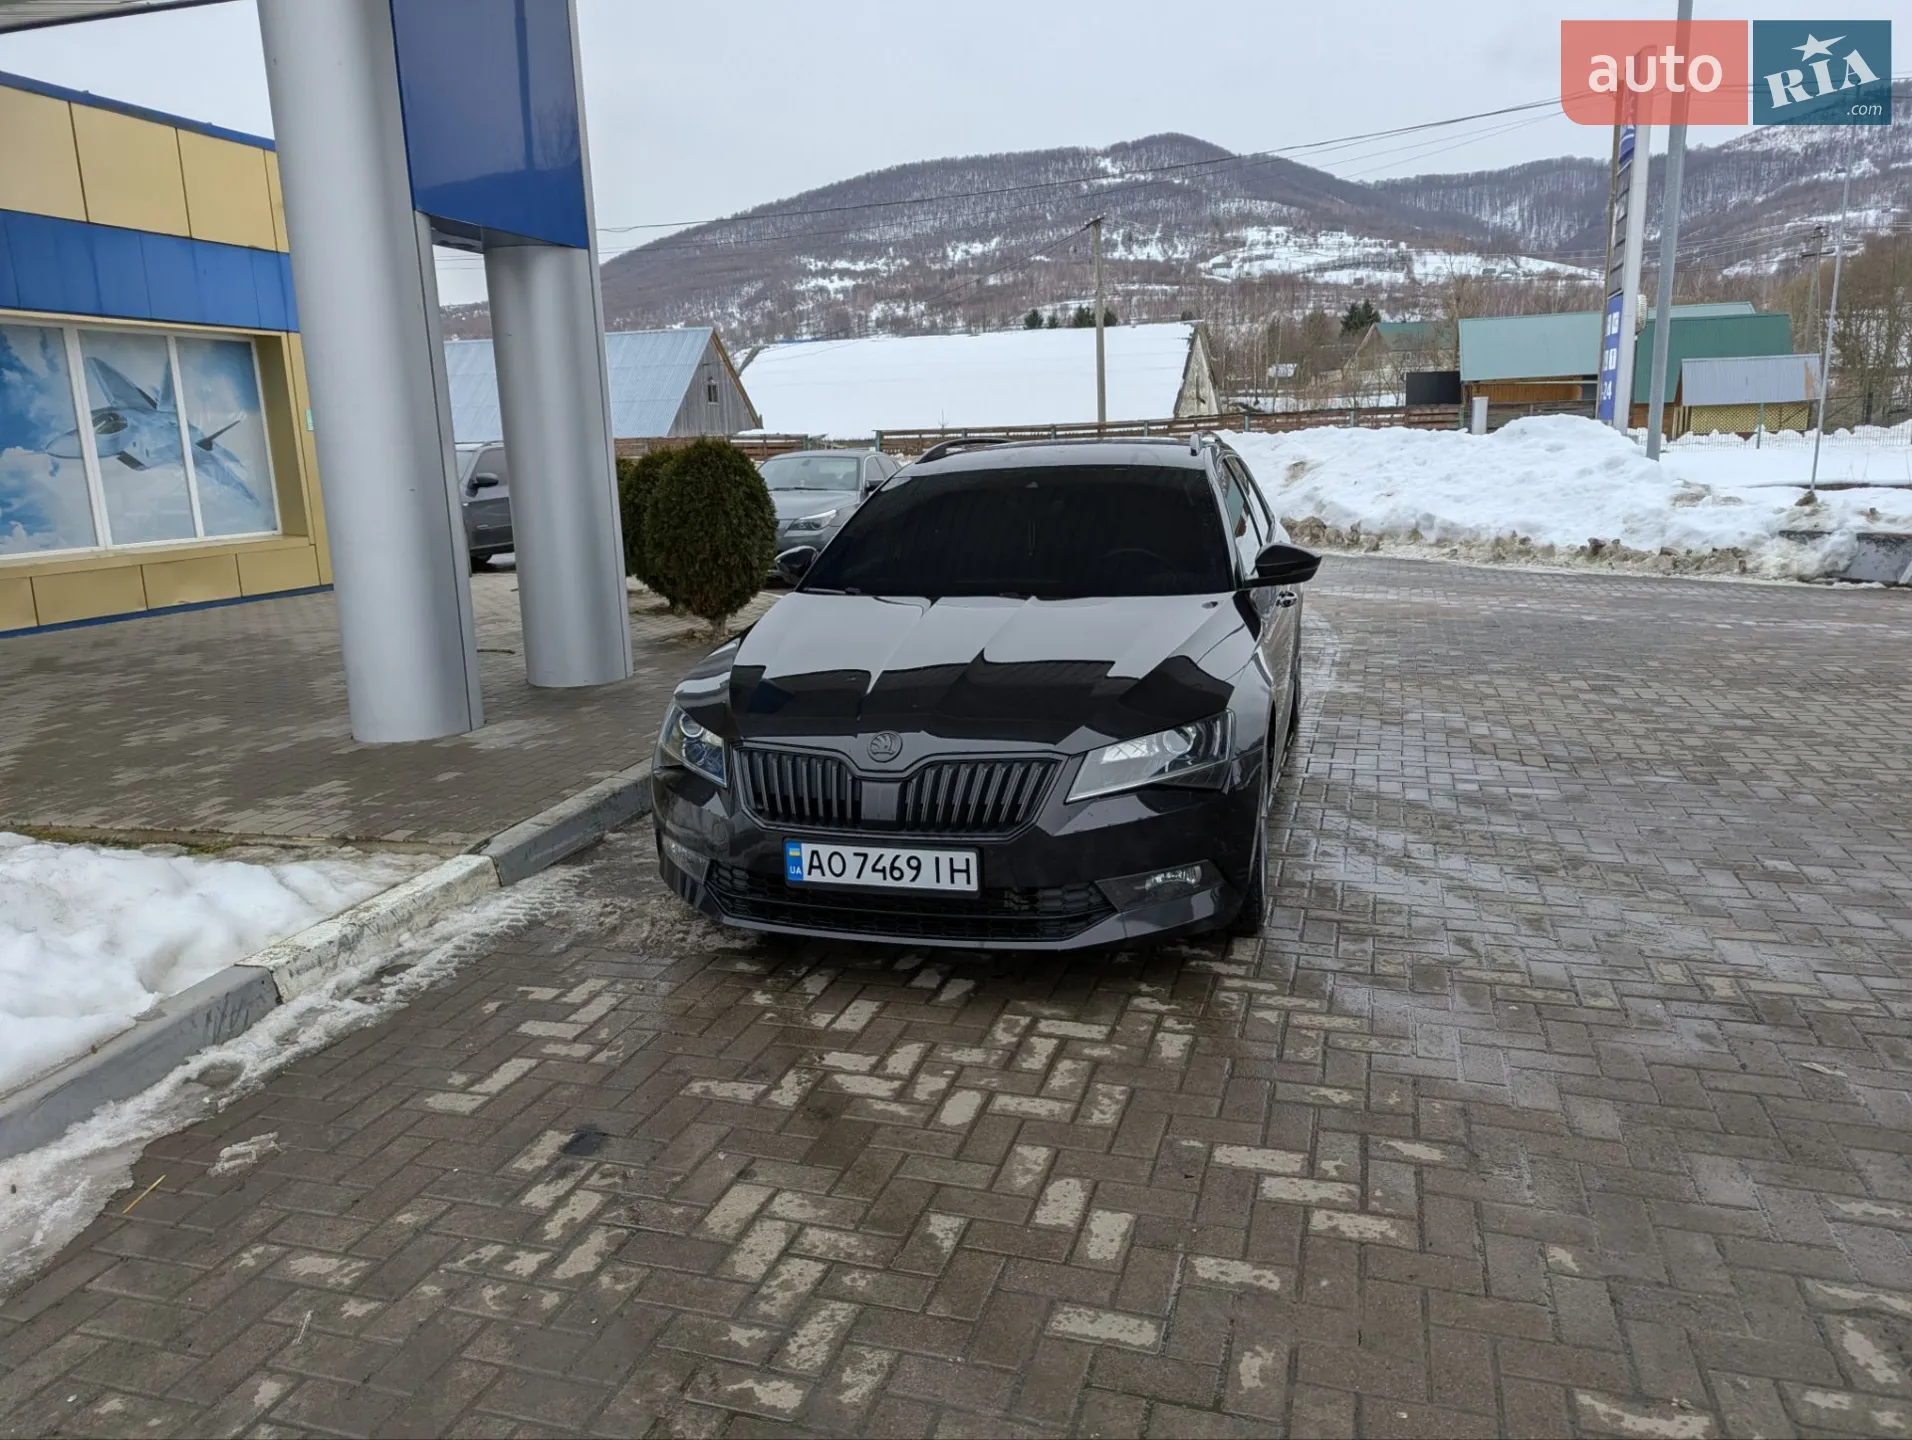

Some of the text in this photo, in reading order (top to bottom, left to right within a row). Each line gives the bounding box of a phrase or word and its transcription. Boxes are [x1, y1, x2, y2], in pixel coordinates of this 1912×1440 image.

[789, 866, 803, 875] UA
[807, 850, 971, 885] AO 7469 IH
